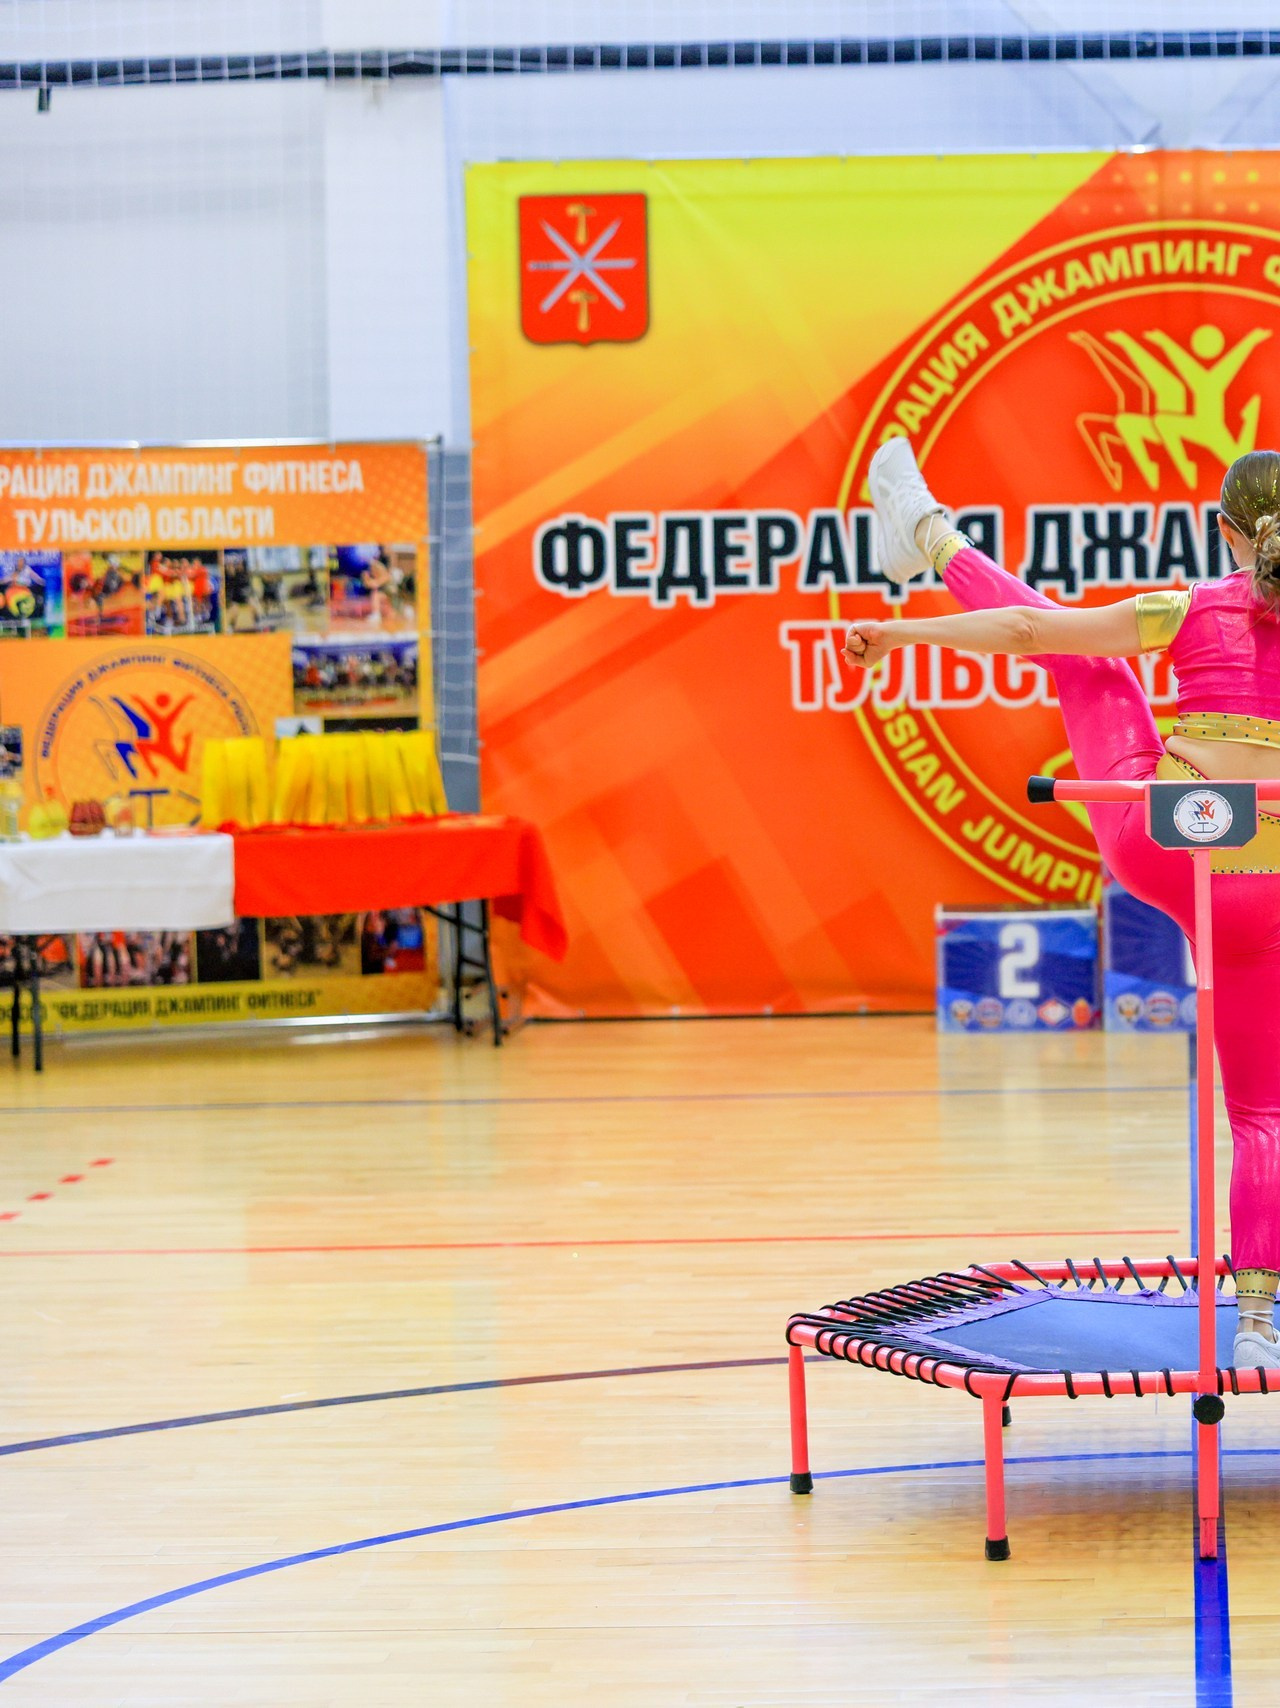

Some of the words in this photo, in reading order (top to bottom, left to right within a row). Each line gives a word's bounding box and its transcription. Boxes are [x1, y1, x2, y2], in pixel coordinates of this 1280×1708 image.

[990, 240, 1252, 339] ДЖАМПИНГ
[85, 461, 239, 501] ДЖАМПИНГ
[243, 459, 365, 496] ФИТНЕСА
[14, 502, 153, 543] ТУЛЬСКОЙ
[156, 505, 275, 542] ОБЛАСТИ
[960, 816, 1101, 904] JUMPI
[998, 922, 1041, 999] 2
